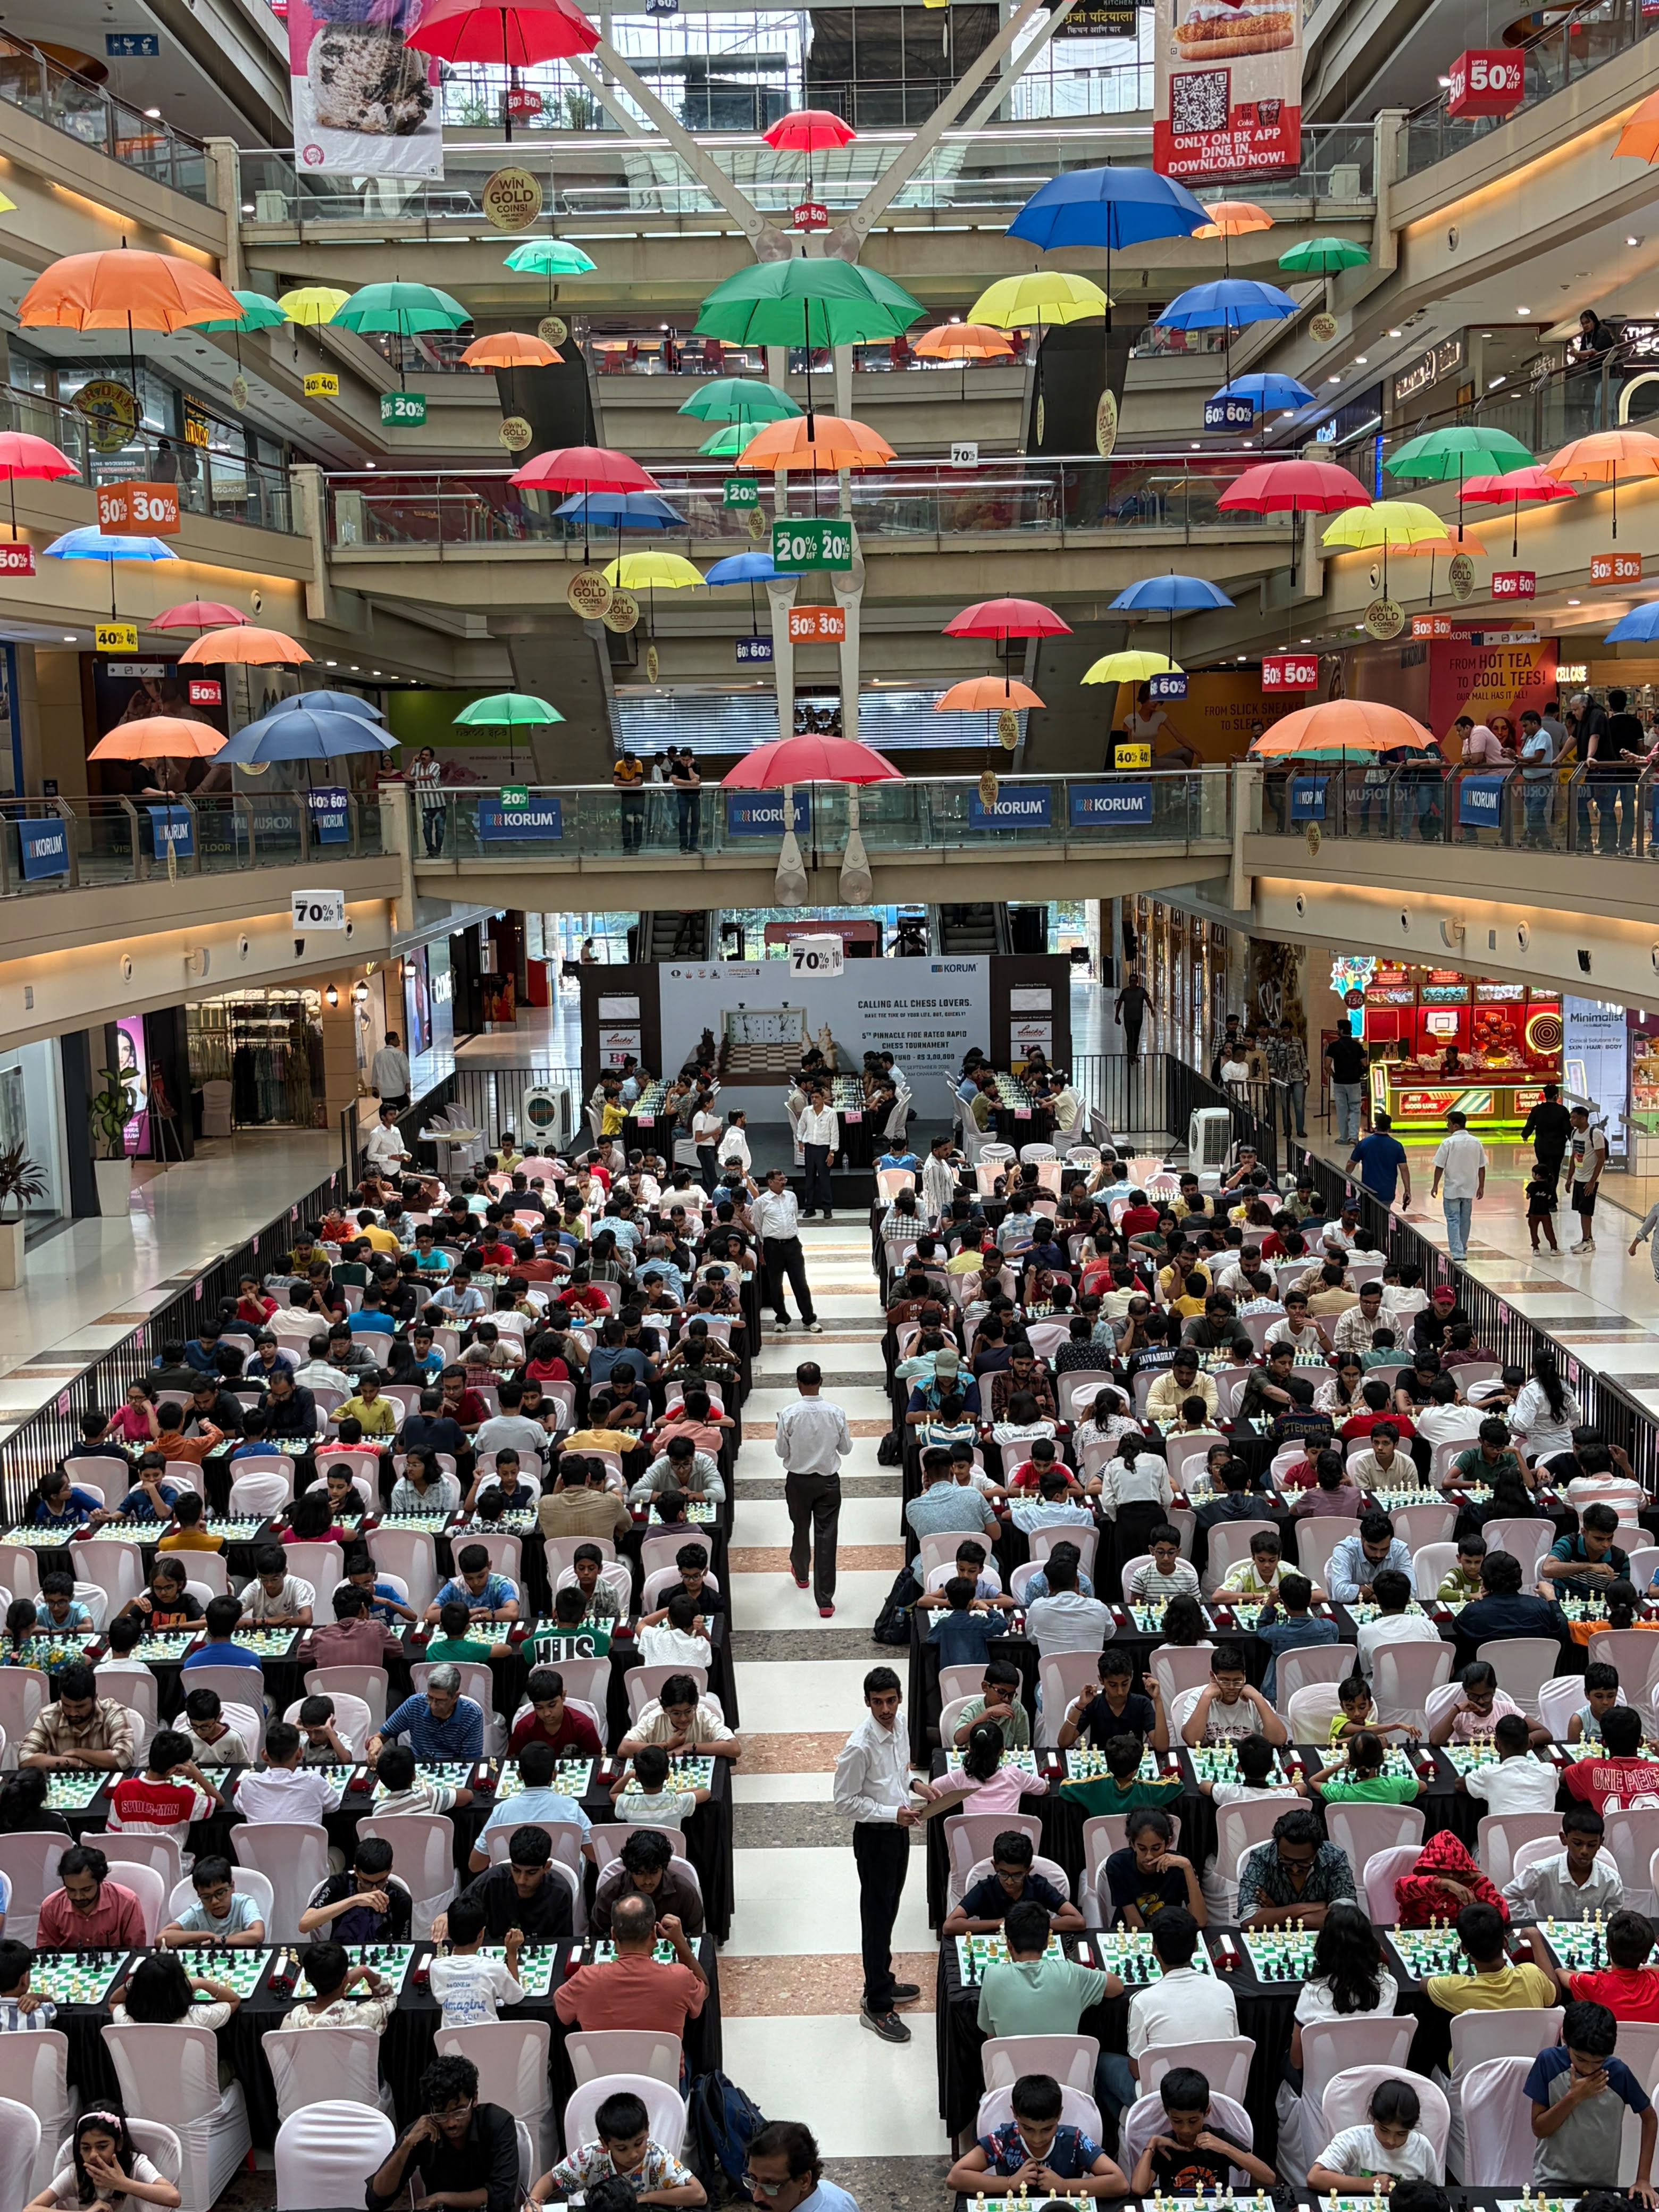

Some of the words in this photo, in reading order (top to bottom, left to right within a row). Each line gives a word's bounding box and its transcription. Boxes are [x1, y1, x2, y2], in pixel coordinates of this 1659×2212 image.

[1470, 65, 1521, 90] 50%
[1174, 135, 1209, 149] ONLY
[1211, 133, 1231, 144] ON
[1235, 130, 1252, 143] BK
[1254, 127, 1281, 141] APP
[1201, 145, 1233, 158] DINE
[1235, 143, 1253, 155] IN.
[1169, 155, 1245, 173] DOWNLOAD
[1249, 150, 1285, 165] NOW!
[499, 178, 524, 190] WIN
[490, 191, 534, 204] GOLD
[497, 205, 527, 213] COINS!
[395, 402, 425, 417] 20%
[1227, 406, 1252, 422] 60%
[953, 450, 976, 461] 70%
[133, 497, 177, 522] 30%
[777, 536, 818, 562] 20%
[822, 536, 850, 559] 20%
[1452, 571, 1471, 580] GOLD
[1614, 562, 1640, 576] 30%
[581, 577, 599, 586] WIN
[574, 586, 606, 598] GOLD
[1369, 613, 1399, 621] GOLD
[98, 631, 124, 645] 40%
[1450, 658, 1476, 669] FROM
[1479, 654, 1504, 669] HOT
[1509, 652, 1532, 667] TEA
[1285, 665, 1316, 683] 50%
[1457, 676, 1468, 688] TO
[1473, 673, 1506, 687] COOL
[1510, 670, 1546, 685] TEES!
[1556, 666, 1570, 682] CELL
[1571, 665, 1587, 682] CASE
[1160, 681, 1186, 694] 60%
[1205, 706, 1228, 716] FROM
[1230, 702, 1259, 715] SLICK
[1000, 724, 1016, 732] GOLD
[1221, 720, 1230, 731] TO
[1095, 798, 1143, 811] KORUM
[1472, 790, 1496, 809] KORUM
[994, 801, 1043, 815] KORUM
[323, 814, 344, 828] KORUM
[505, 812, 554, 826] KORUM
[36, 835, 63, 858] KORUM
[200, 843, 231, 852] FLOOR
[296, 904, 334, 921] 70%
[793, 952, 829, 969] 70%
[944, 963, 977, 973] KORUM
[858, 1000, 891, 1009] CALLING
[894, 1000, 909, 1008] ALL
[911, 999, 937, 1008] CHESS
[939, 999, 972, 1007] LOVERS.
[1570, 1012, 1623, 1023] Minimalist
[607, 1033, 634, 1045] Lucky
[1593, 1767, 1623, 1791] ONE
[121, 1799, 180, 1816] SPIDER-MAN
